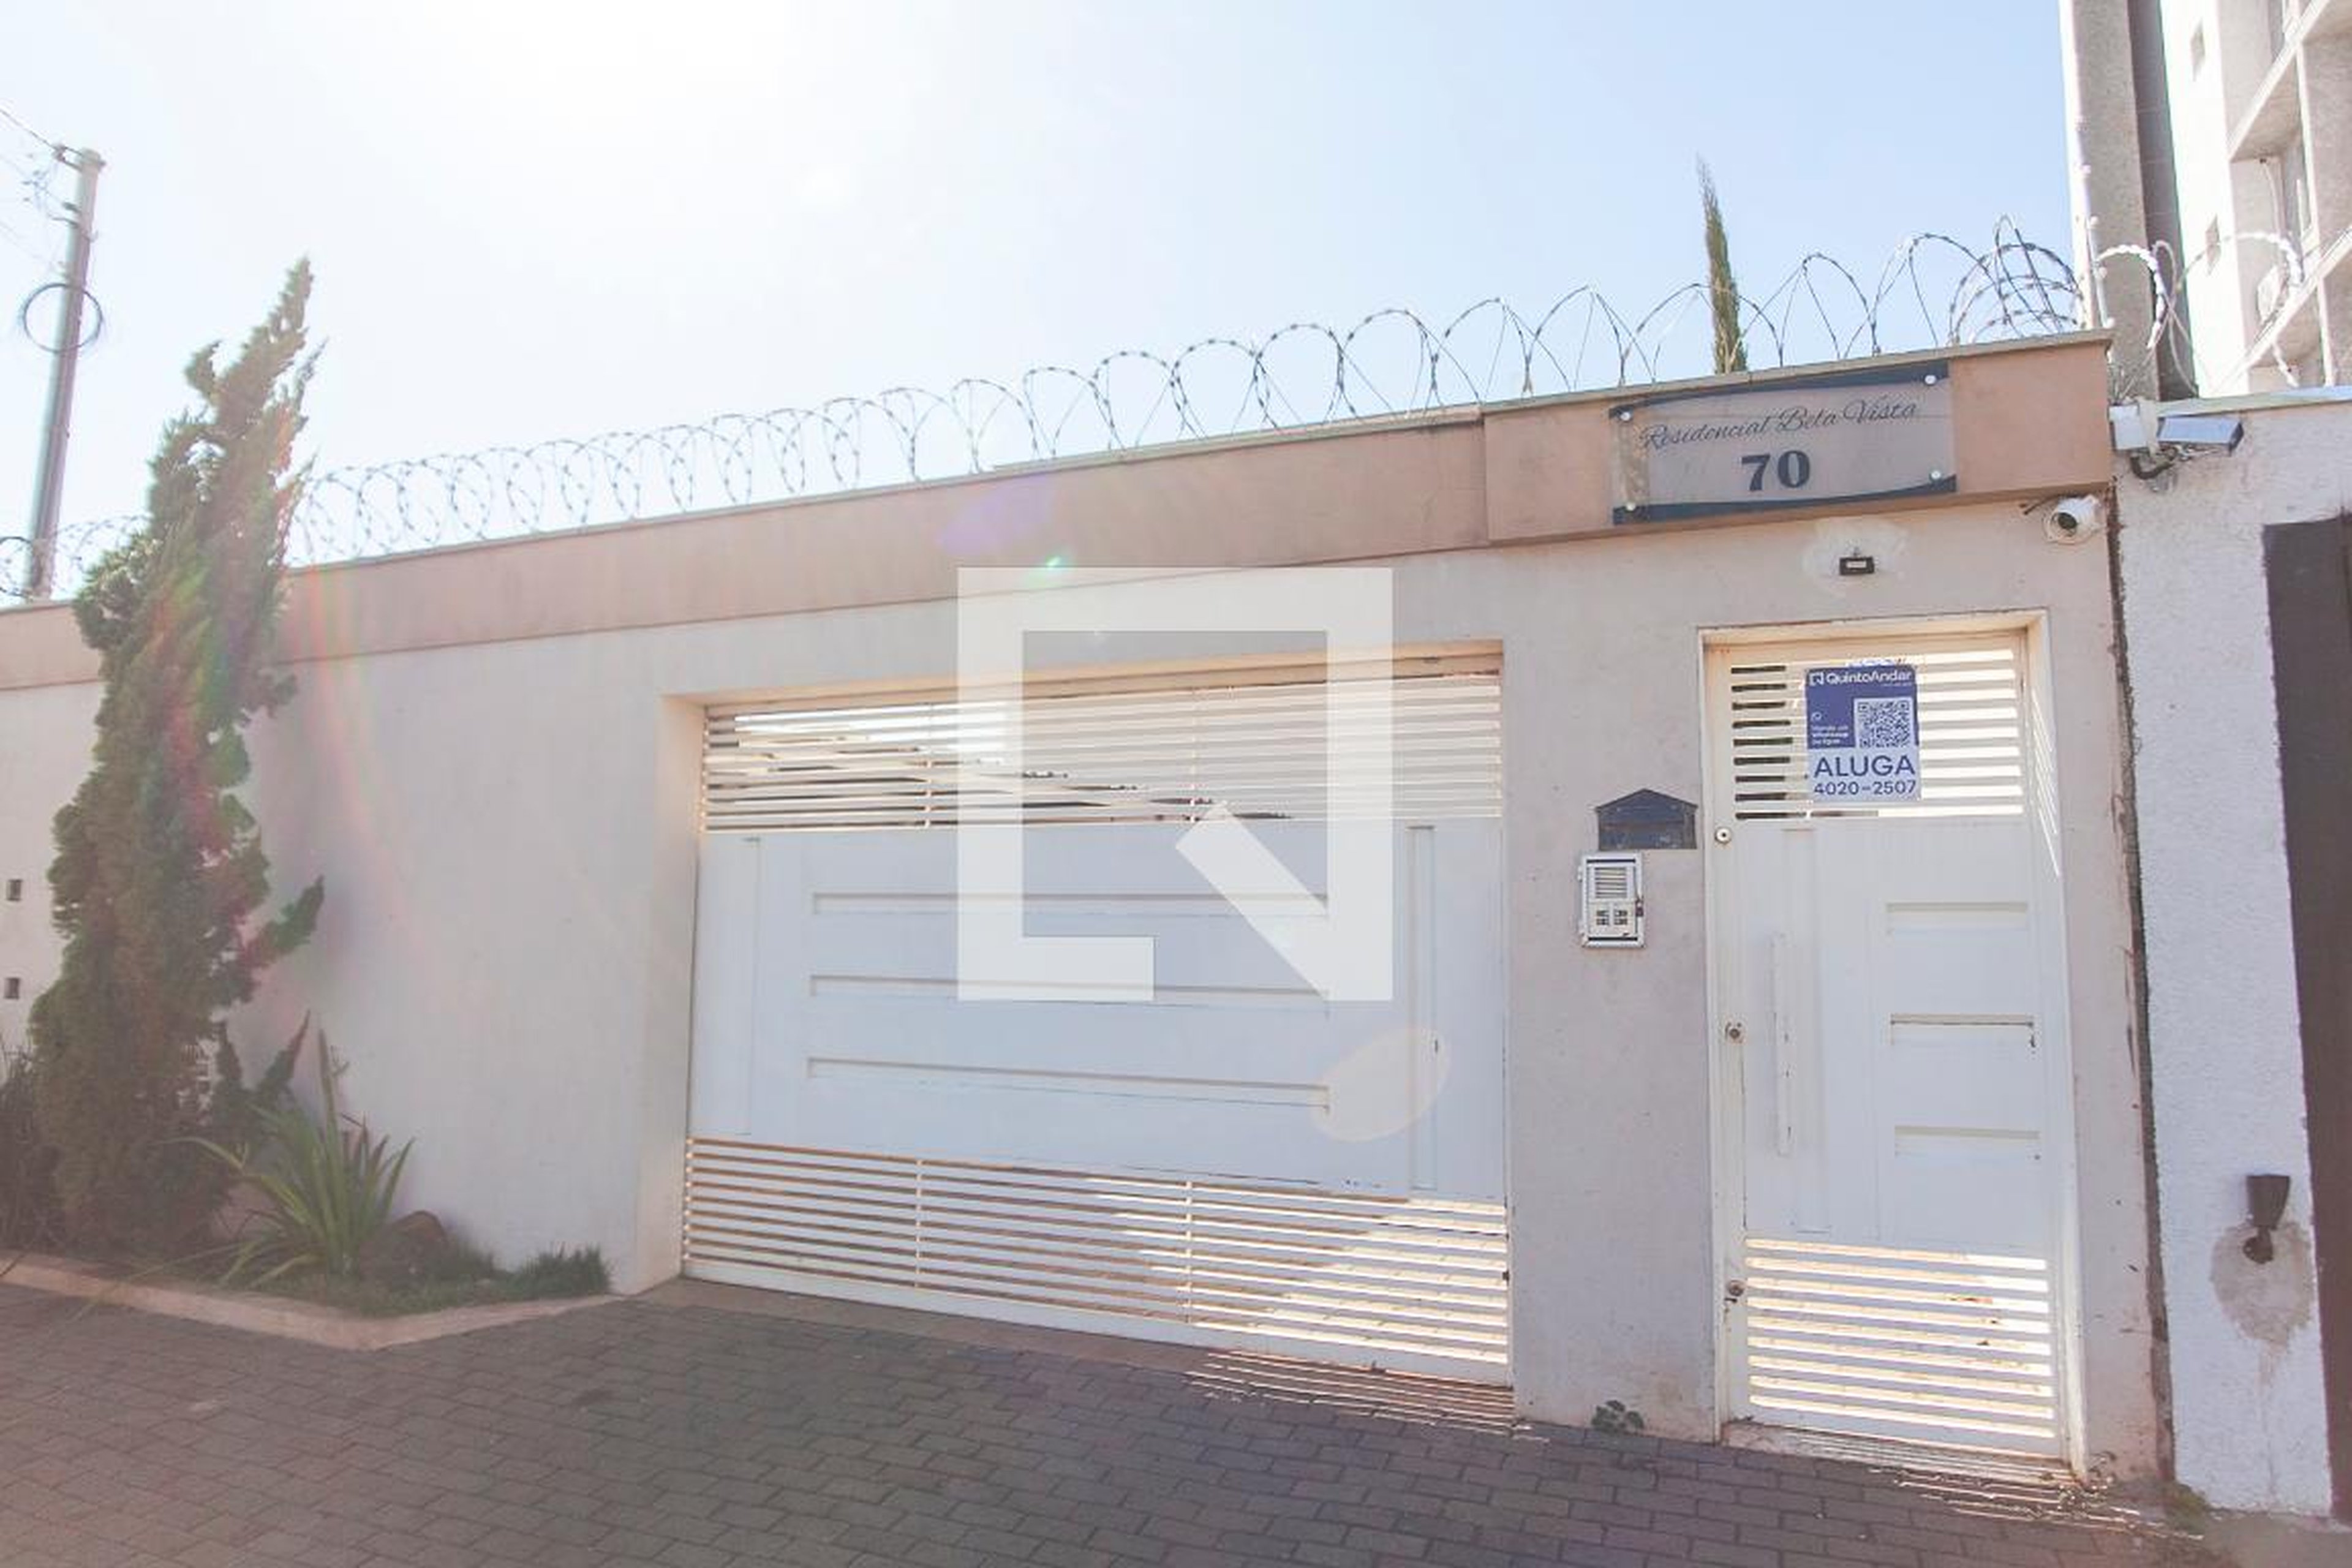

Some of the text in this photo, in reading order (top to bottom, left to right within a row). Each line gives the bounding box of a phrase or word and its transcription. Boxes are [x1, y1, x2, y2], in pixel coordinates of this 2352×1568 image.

[1639, 395, 1916, 450] Residencial Bela Vista
[1741, 450, 1811, 491] 70
[1826, 670, 1912, 685] QuintoAndar
[1814, 755, 1915, 778] ALUGA
[1814, 780, 1916, 794] 4020-2507
